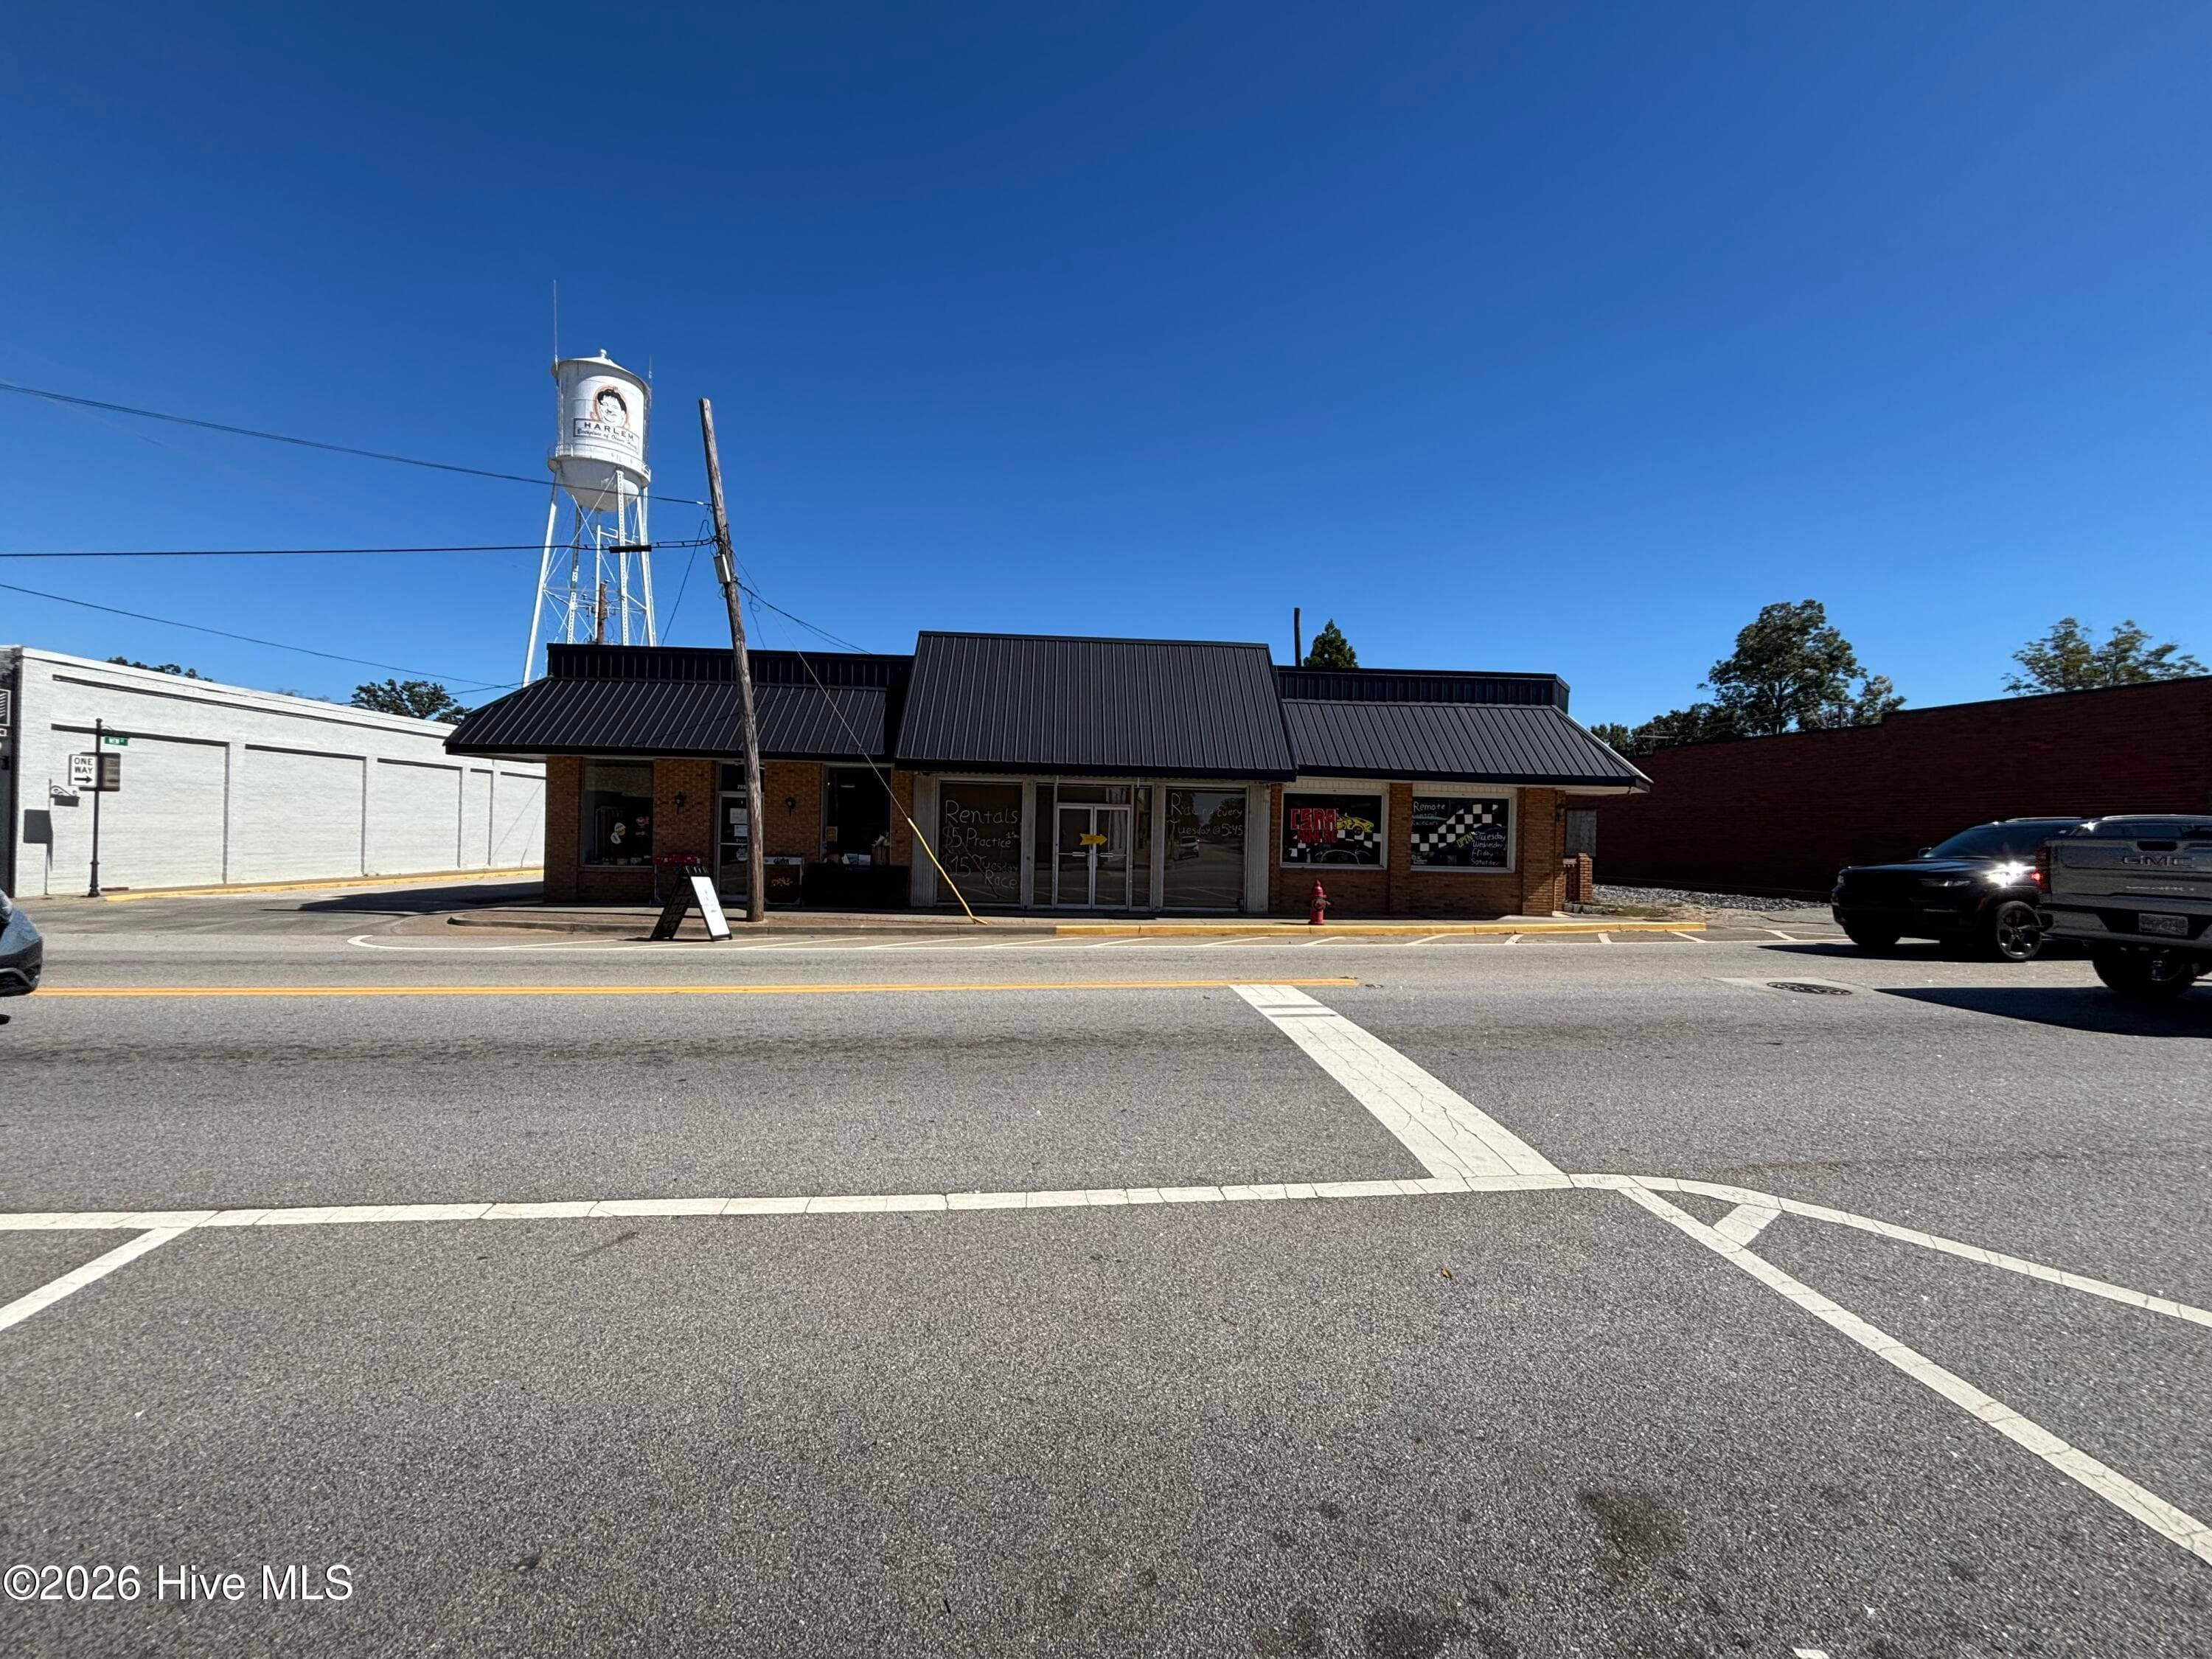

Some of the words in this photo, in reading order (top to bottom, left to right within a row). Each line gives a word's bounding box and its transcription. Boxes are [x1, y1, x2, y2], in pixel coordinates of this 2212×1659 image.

[585, 422, 633, 441] HARLEM
[74, 757, 93, 765] ONE
[945, 800, 1018, 824] Rentals
[1413, 801, 1445, 814] Remote
[1290, 808, 1336, 830] CSRA
[967, 827, 1012, 848] Practice
[1456, 832, 1473, 848] OPEN
[2124, 856, 2197, 868] GMC
[984, 869, 1018, 889] Race
